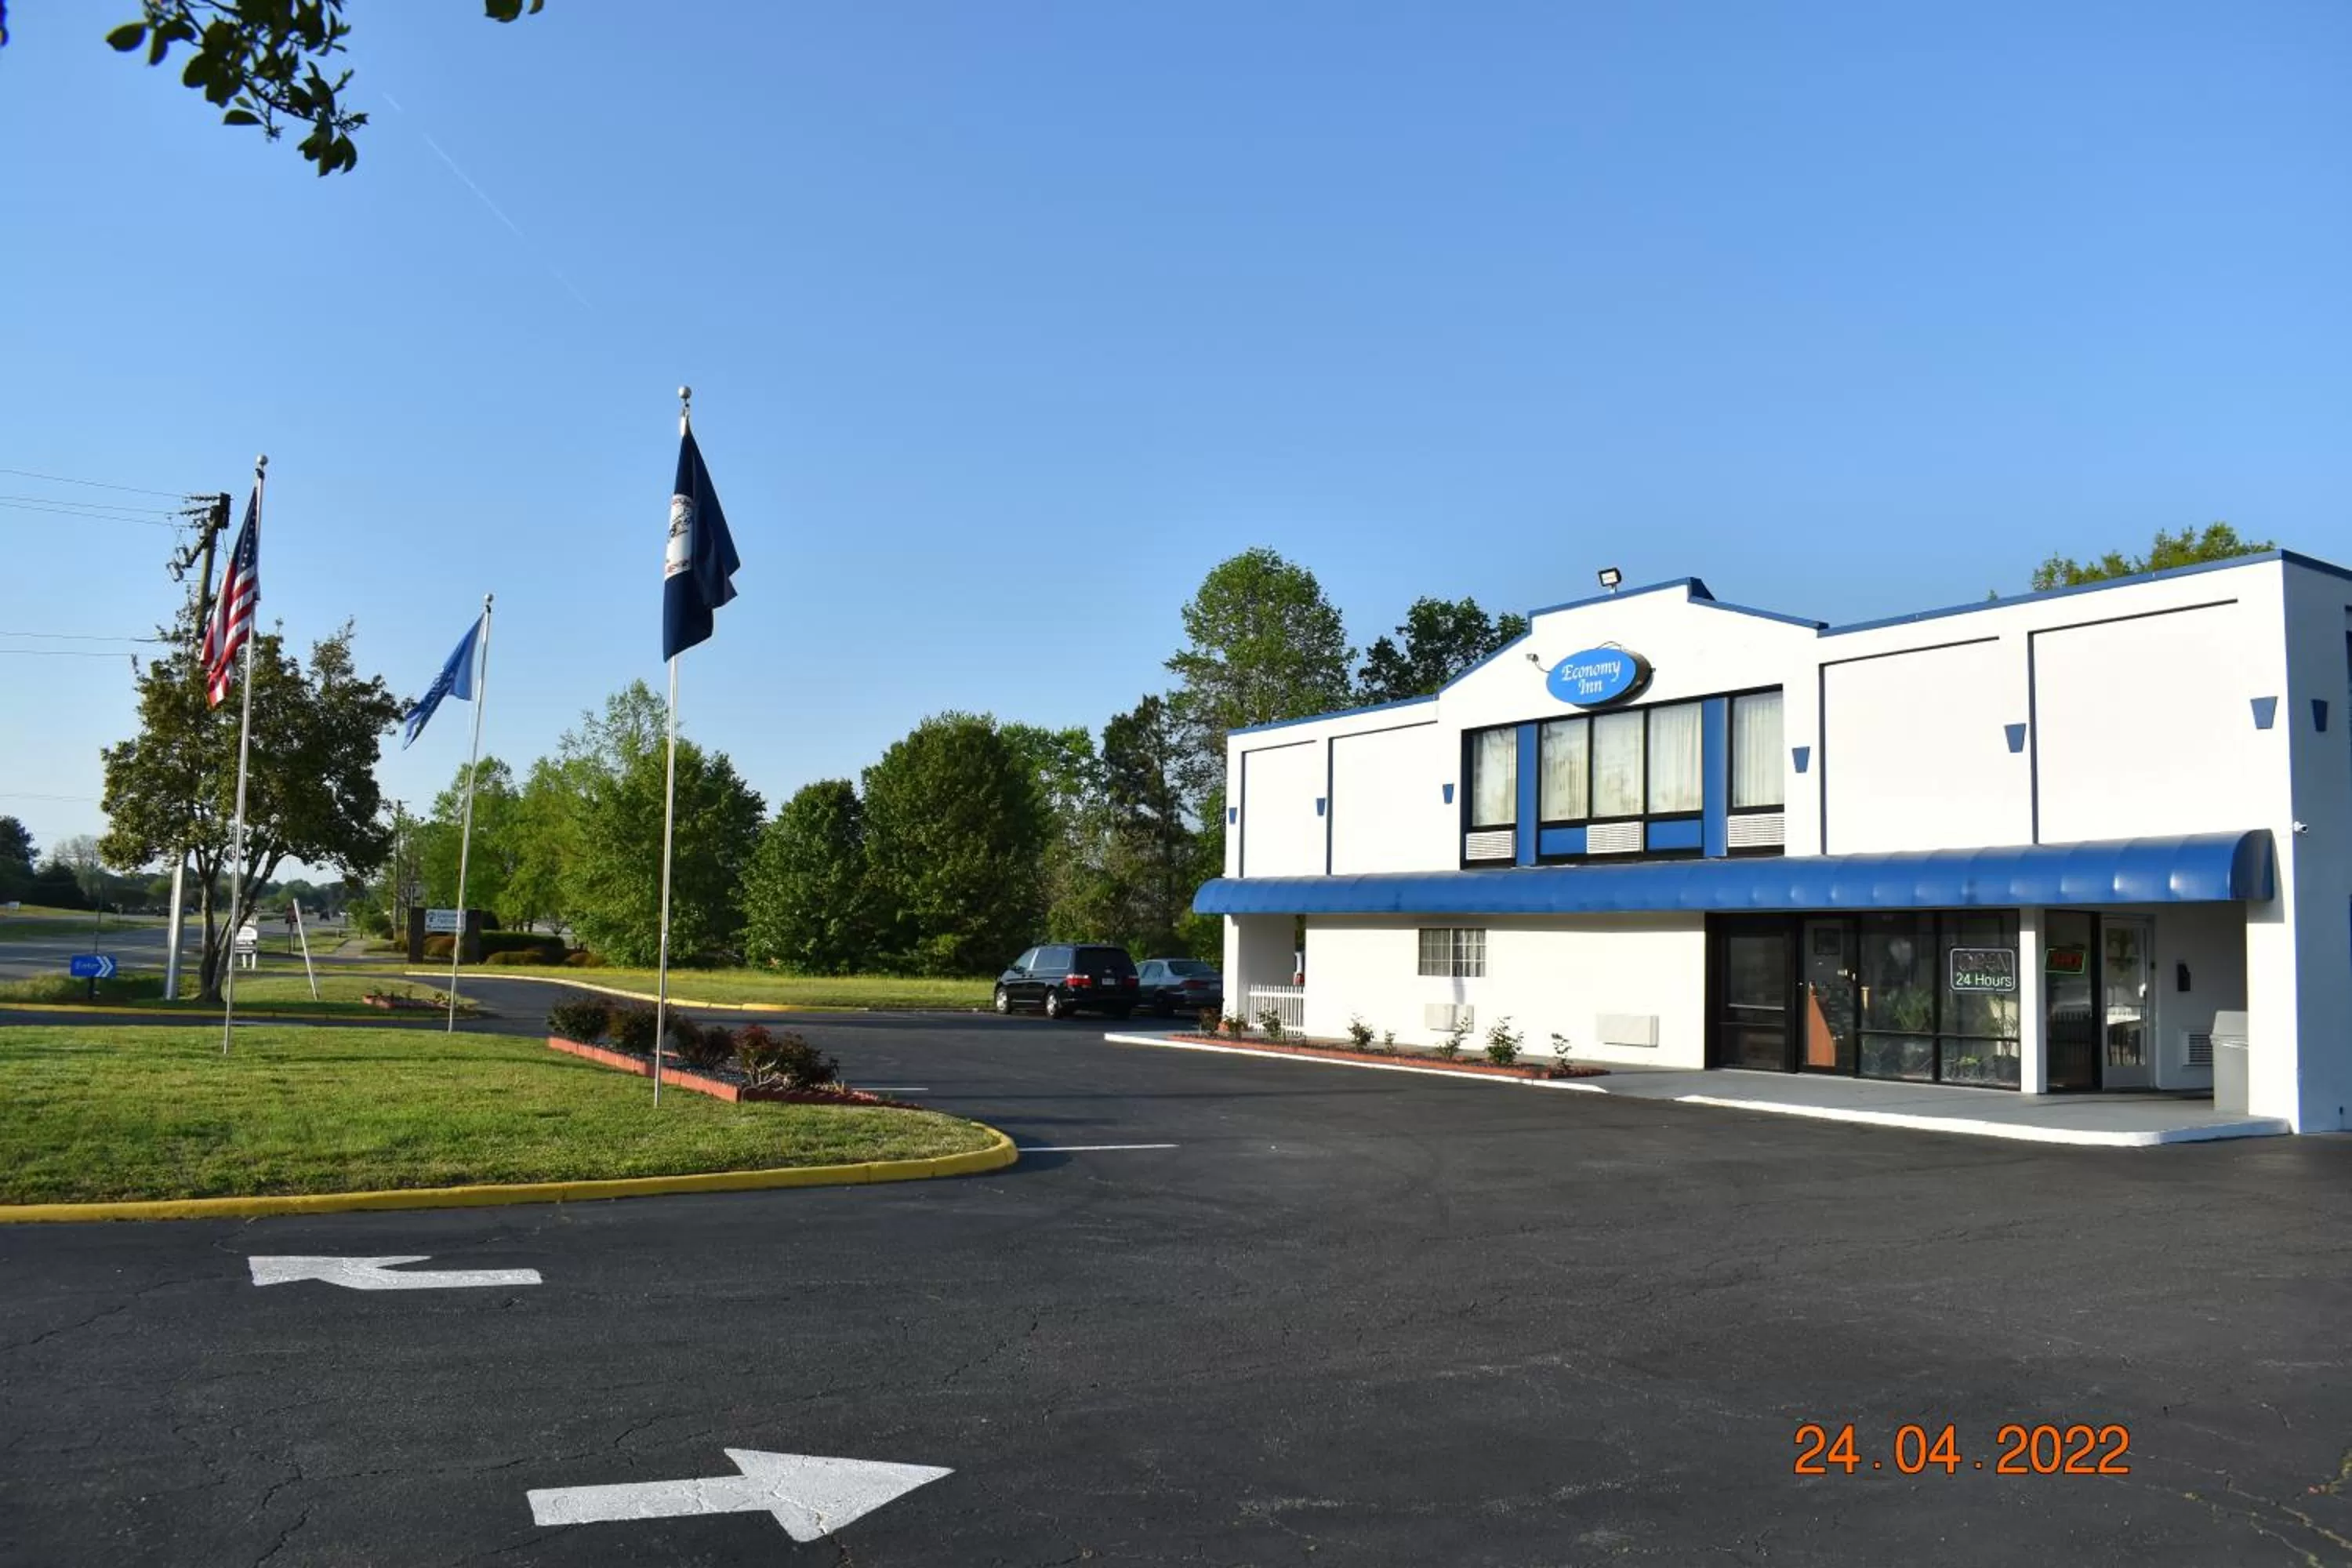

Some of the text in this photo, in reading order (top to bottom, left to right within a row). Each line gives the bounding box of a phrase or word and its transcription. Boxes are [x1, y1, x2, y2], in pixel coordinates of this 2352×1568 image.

[1562, 660, 1621, 682] Economy
[1578, 679, 1602, 695] Inn
[1956, 971, 2013, 987] 24 Hours
